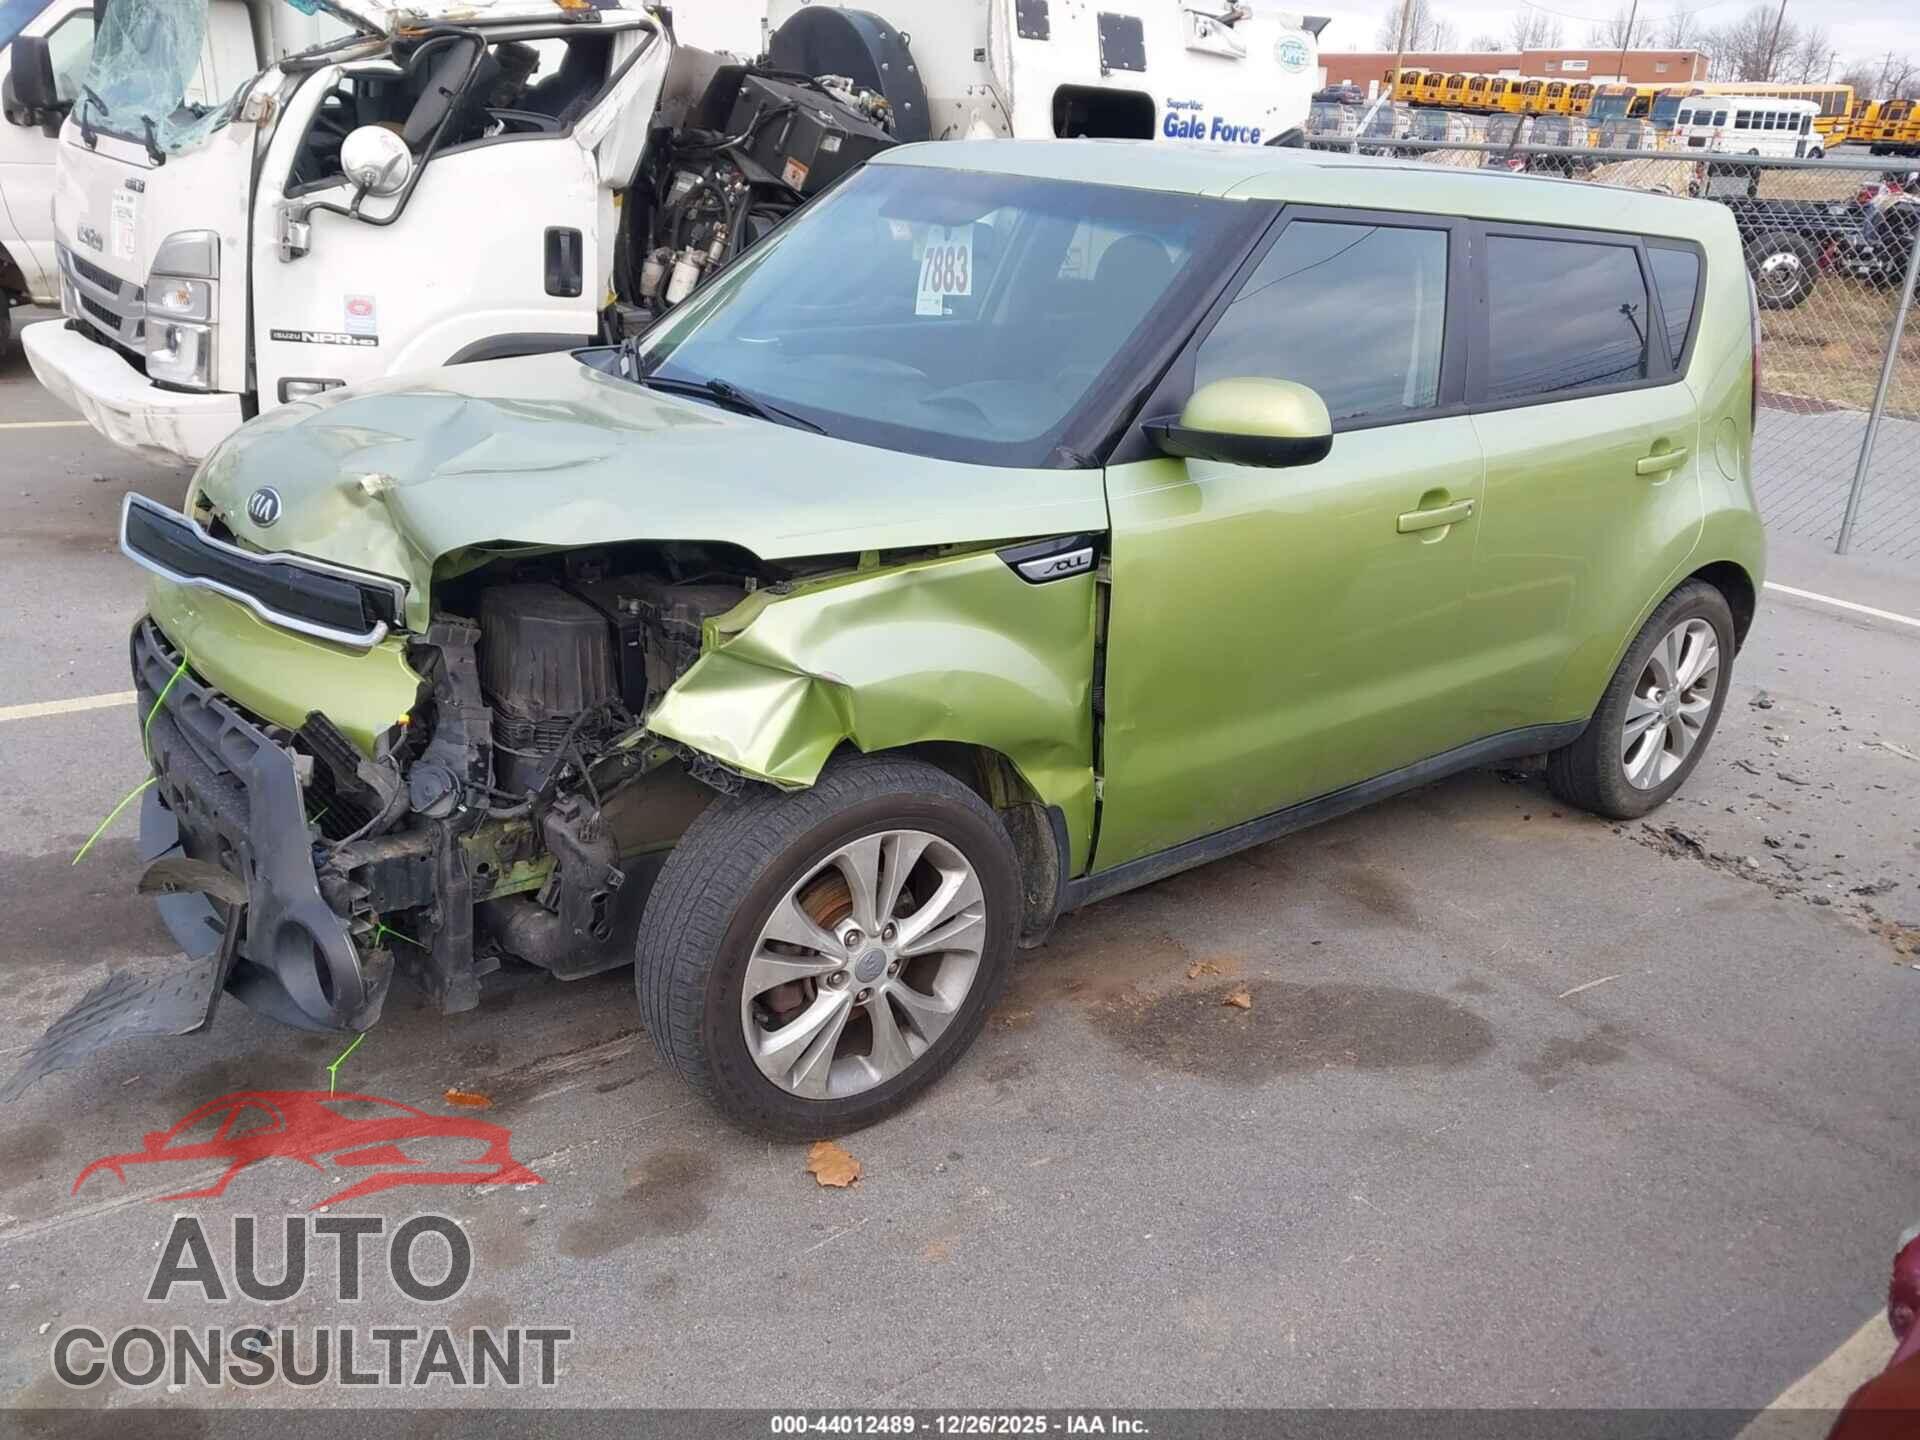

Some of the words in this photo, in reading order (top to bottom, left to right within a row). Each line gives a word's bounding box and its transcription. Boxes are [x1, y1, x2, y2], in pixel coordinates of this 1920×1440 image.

[1163, 112, 1206, 139] Gale
[1210, 116, 1261, 144] Force
[922, 246, 968, 293] 7883
[251, 493, 273, 521] KIA
